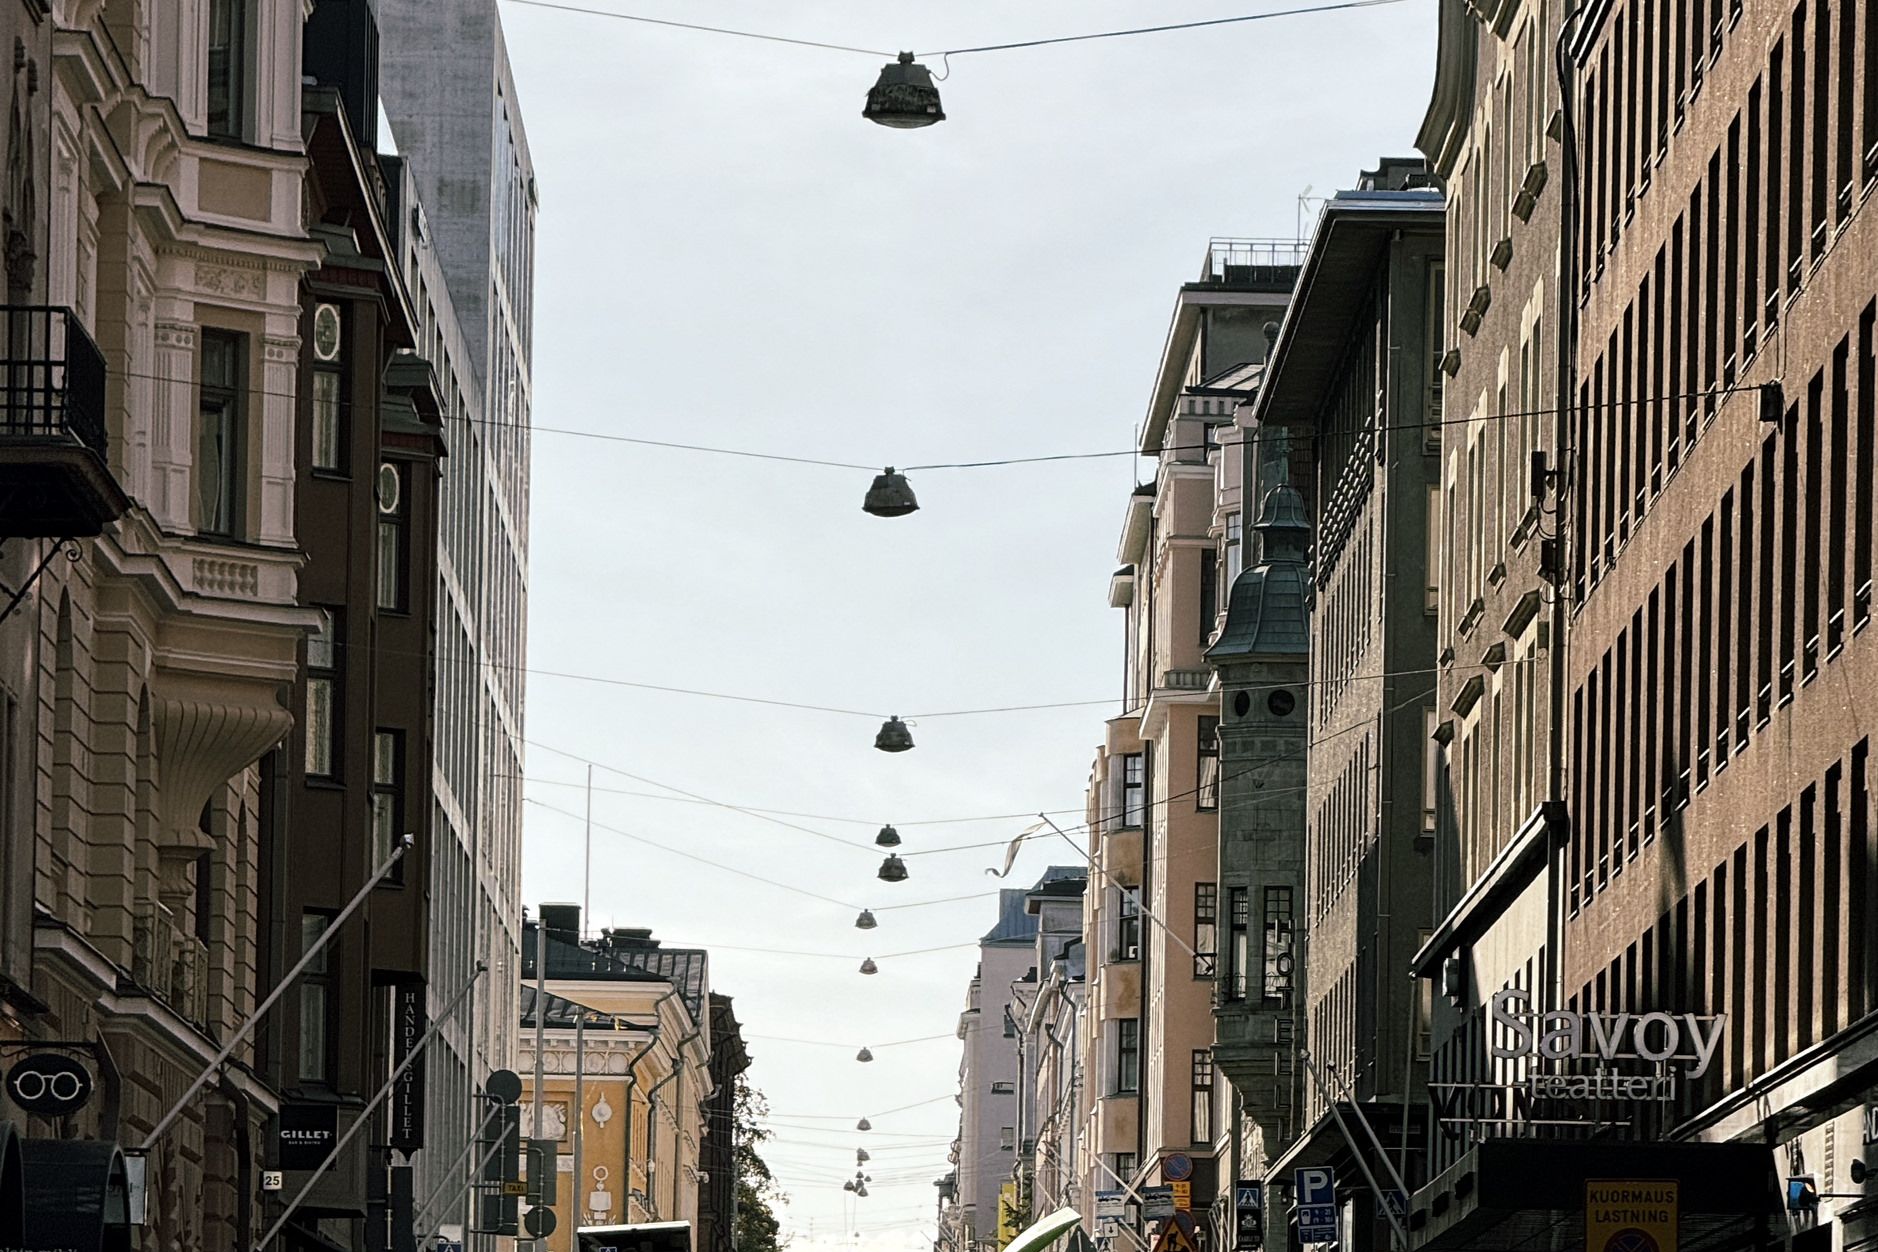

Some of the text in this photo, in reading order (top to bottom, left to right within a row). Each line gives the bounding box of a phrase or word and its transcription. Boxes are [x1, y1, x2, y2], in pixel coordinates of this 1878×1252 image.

[1492, 988, 1728, 1080] Savoy
[1529, 1065, 1676, 1101] teatteri
[281, 1130, 331, 1139] GILLET
[265, 1175, 280, 1186] 25
[1303, 1170, 1329, 1203] P
[1590, 1190, 1675, 1203] KUORMAUS
[1595, 1210, 1669, 1223] LASTNING
